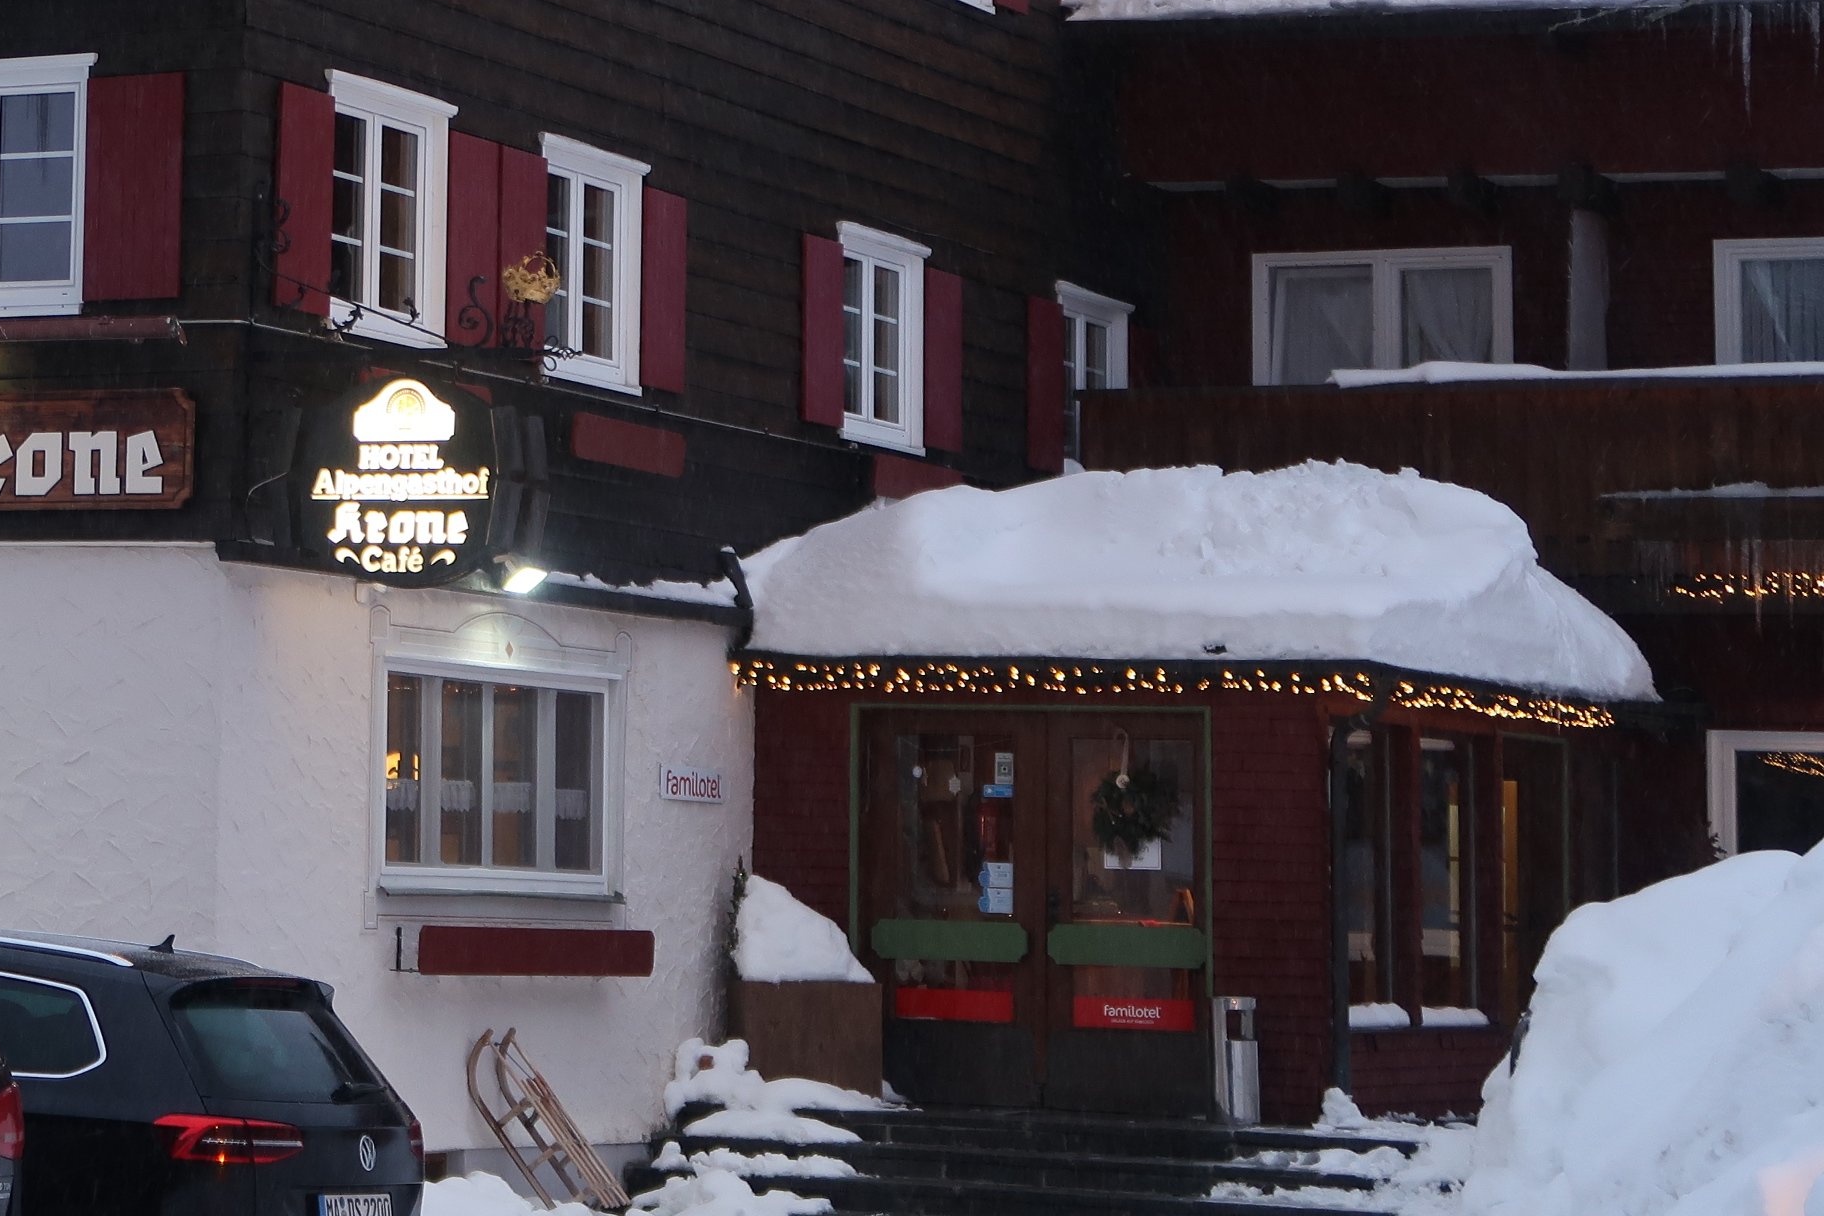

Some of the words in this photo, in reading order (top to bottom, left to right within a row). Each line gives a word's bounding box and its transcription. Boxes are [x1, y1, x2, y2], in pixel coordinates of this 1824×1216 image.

[358, 443, 445, 470] HOTEL
[312, 466, 491, 501] Alpengasthof
[327, 500, 469, 545] Krone
[360, 544, 424, 573] Café
[666, 769, 721, 799] familotel
[1103, 1004, 1161, 1019] familotel
